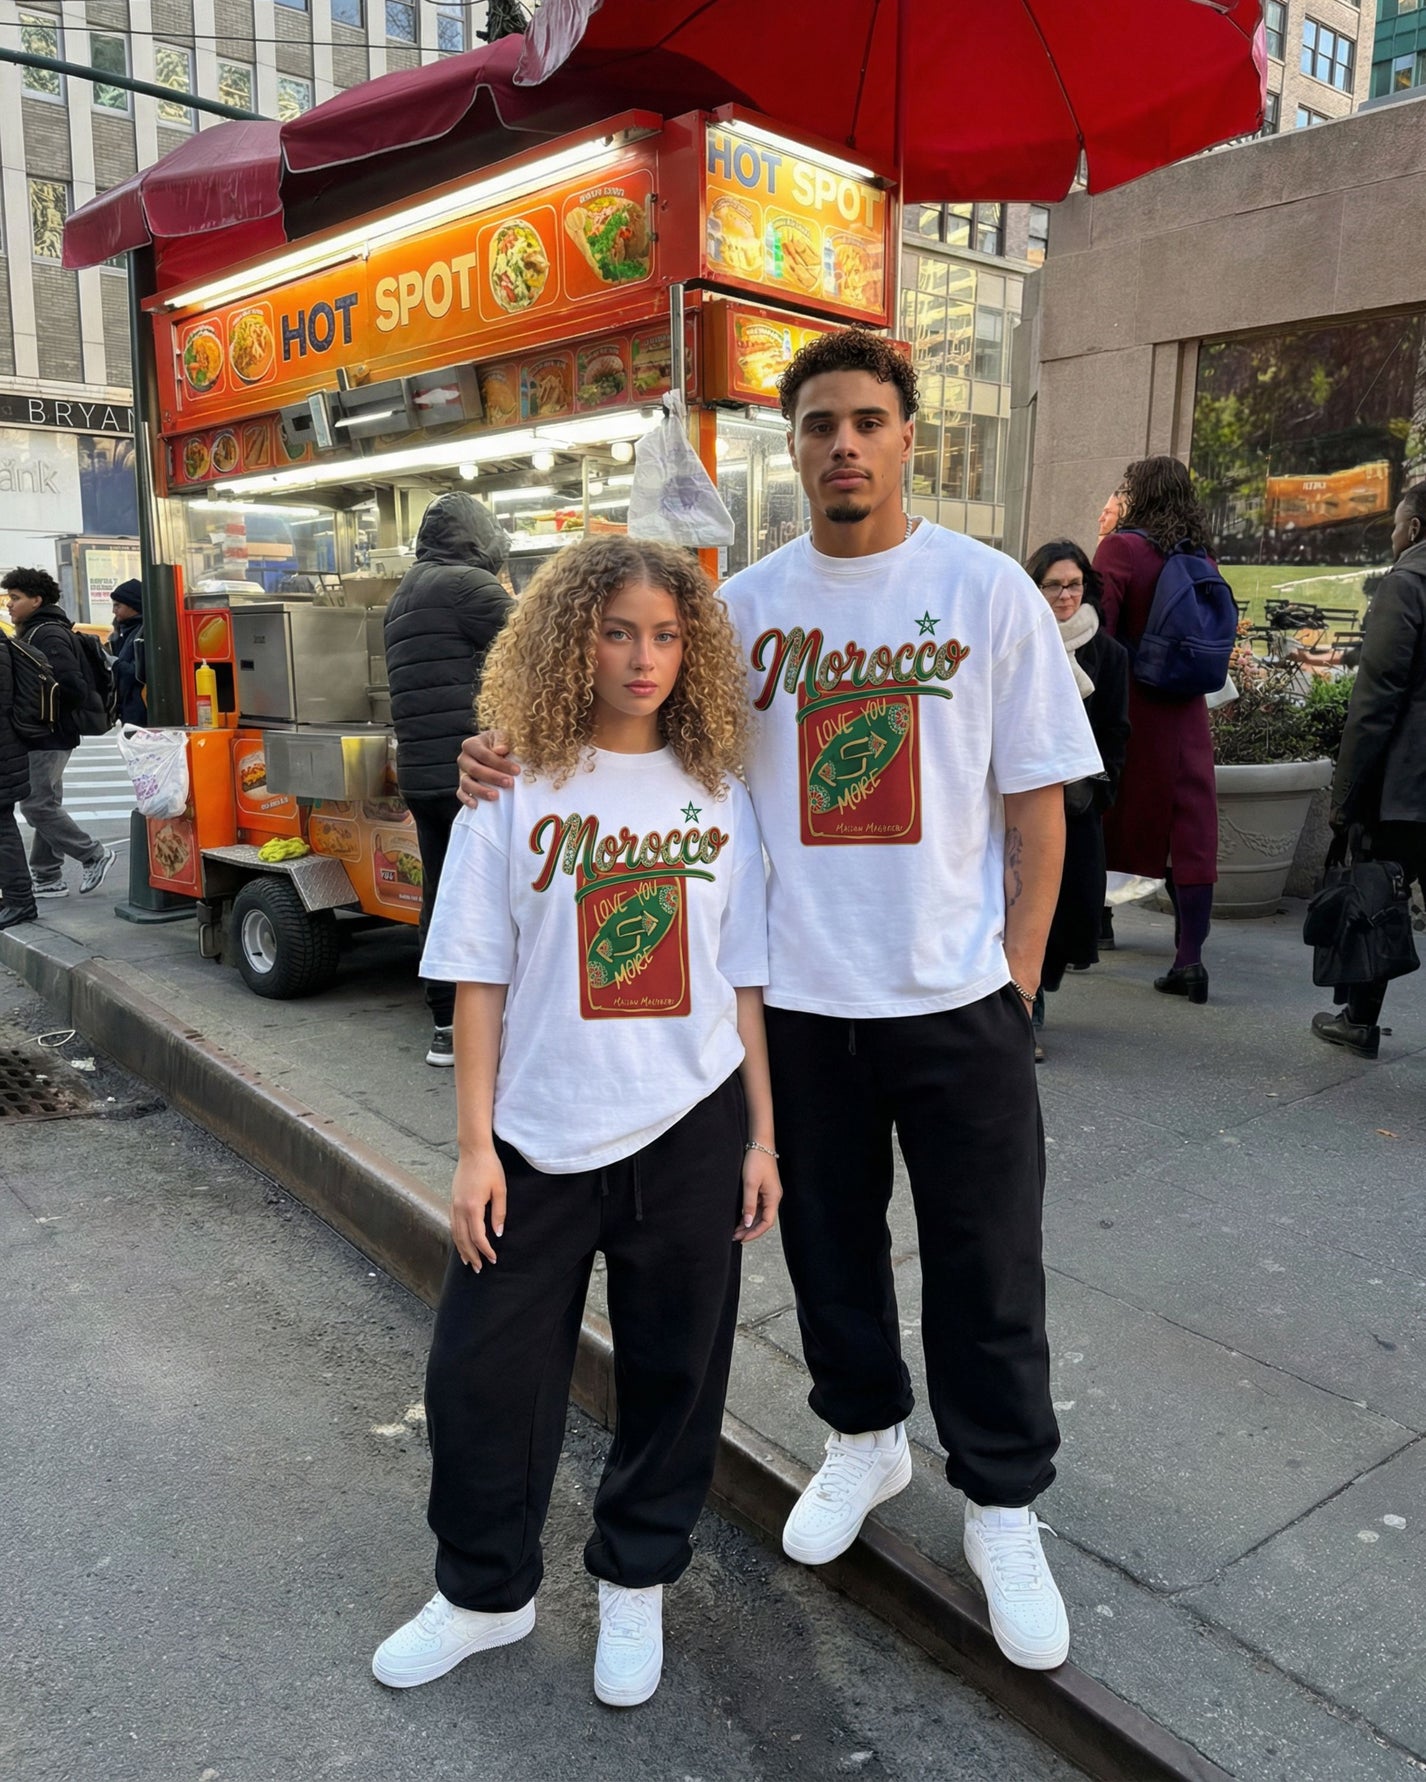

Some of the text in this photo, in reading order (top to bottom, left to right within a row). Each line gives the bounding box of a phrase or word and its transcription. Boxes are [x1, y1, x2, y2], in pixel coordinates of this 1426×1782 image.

[707, 133, 882, 229] HOT SPOT
[281, 252, 477, 361] HOT SPOT
[751, 626, 971, 711] Morocco
[816, 697, 887, 749] LOVE YOU
[837, 767, 881, 815] MORE
[528, 813, 730, 892] Morocco
[593, 880, 659, 927] LOVE YOU
[614, 945, 654, 989] MORE
